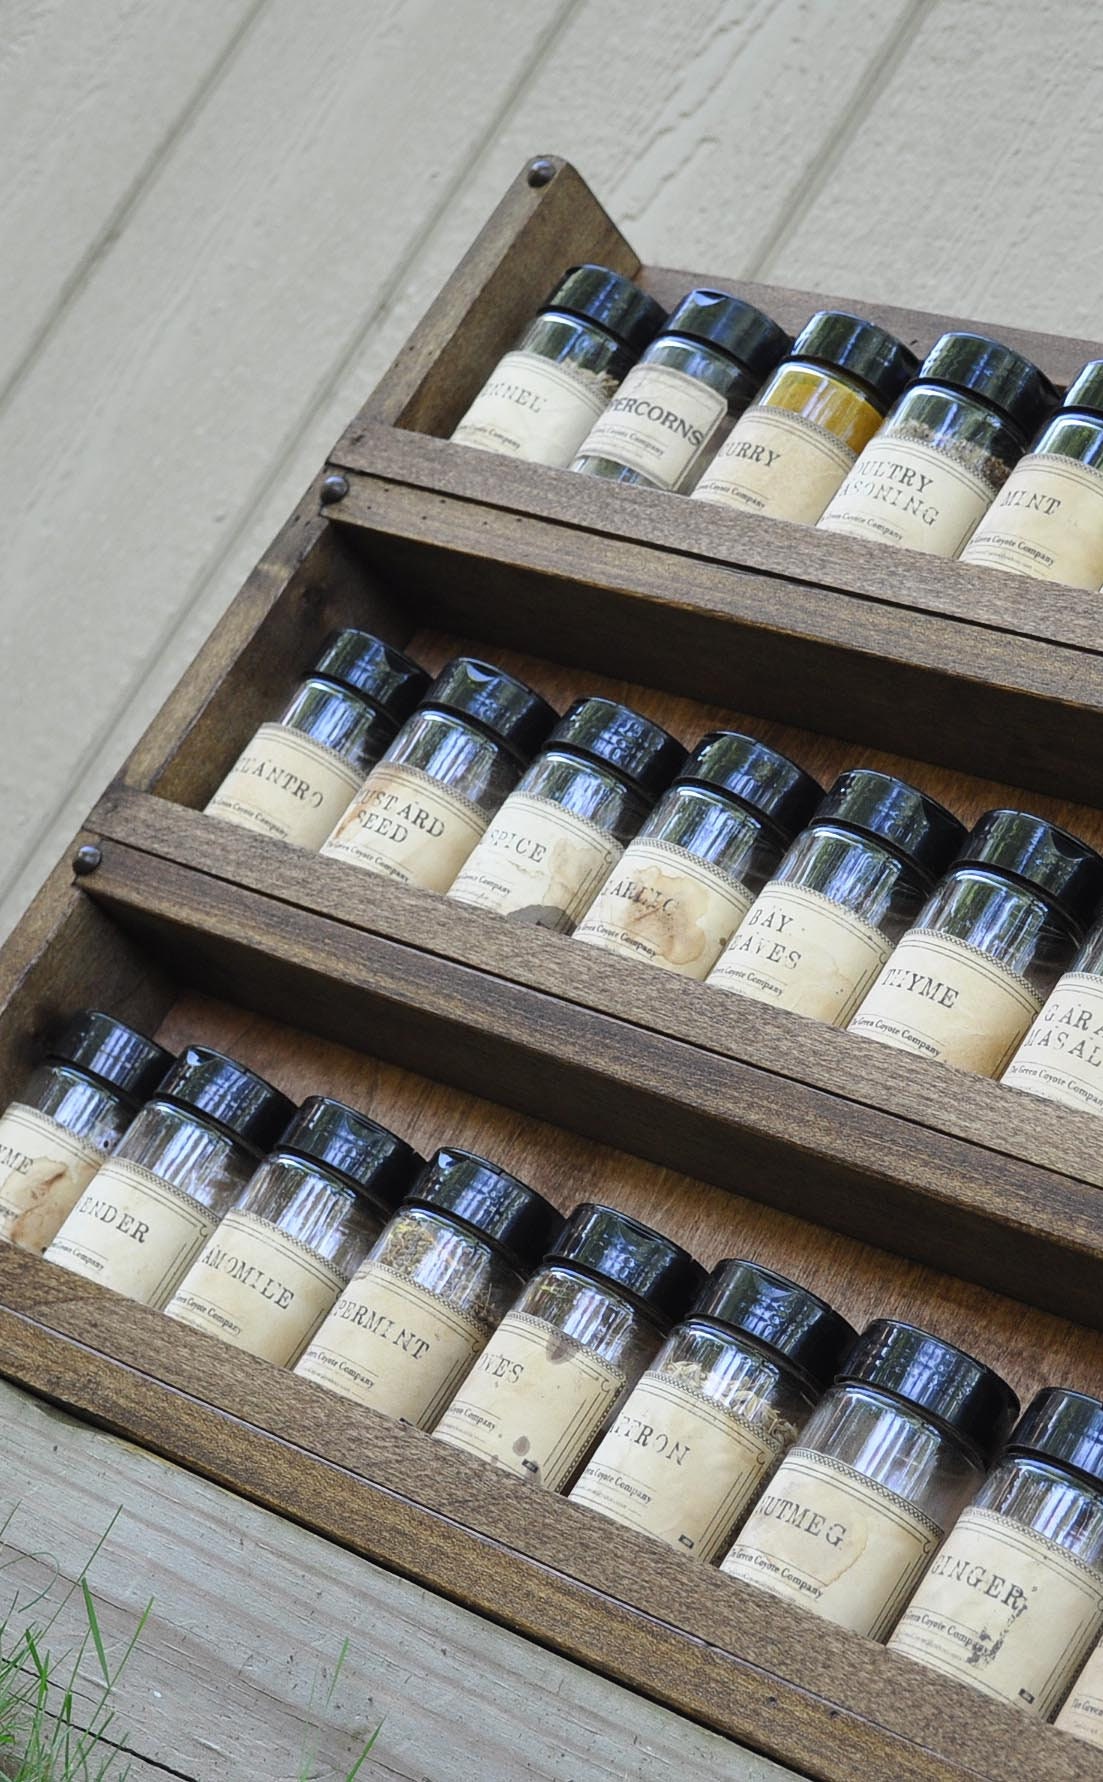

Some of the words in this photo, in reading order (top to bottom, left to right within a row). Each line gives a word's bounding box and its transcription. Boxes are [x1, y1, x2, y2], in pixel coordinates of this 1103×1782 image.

[484, 380, 544, 413] NNEL
[609, 399, 704, 446] PERCORNS
[858, 460, 934, 494] OULTRY
[839, 480, 939, 527] ASONING
[1017, 540, 1055, 567] Company
[234, 758, 324, 808] LANTRO
[356, 814, 409, 843] SEED
[358, 789, 445, 837] USTARD
[375, 856, 409, 882] Company
[748, 908, 794, 934] BAY
[620, 932, 658, 958] Company
[728, 934, 802, 970] EAVES
[747, 971, 783, 998] Company
[881, 968, 959, 1009] THYME
[901, 1028, 941, 1058] Company
[79, 1196, 150, 1244] ENDER
[201, 1246, 295, 1310] AMOMILE
[207, 1305, 241, 1336] Company
[333, 1299, 430, 1360] PERMINT
[339, 1361, 374, 1389] Company
[614, 1476, 652, 1505] Company
[780, 1567, 824, 1599] Company
[930, 1554, 1026, 1613] GINGER
[1081, 1700, 1103, 1717] Green
